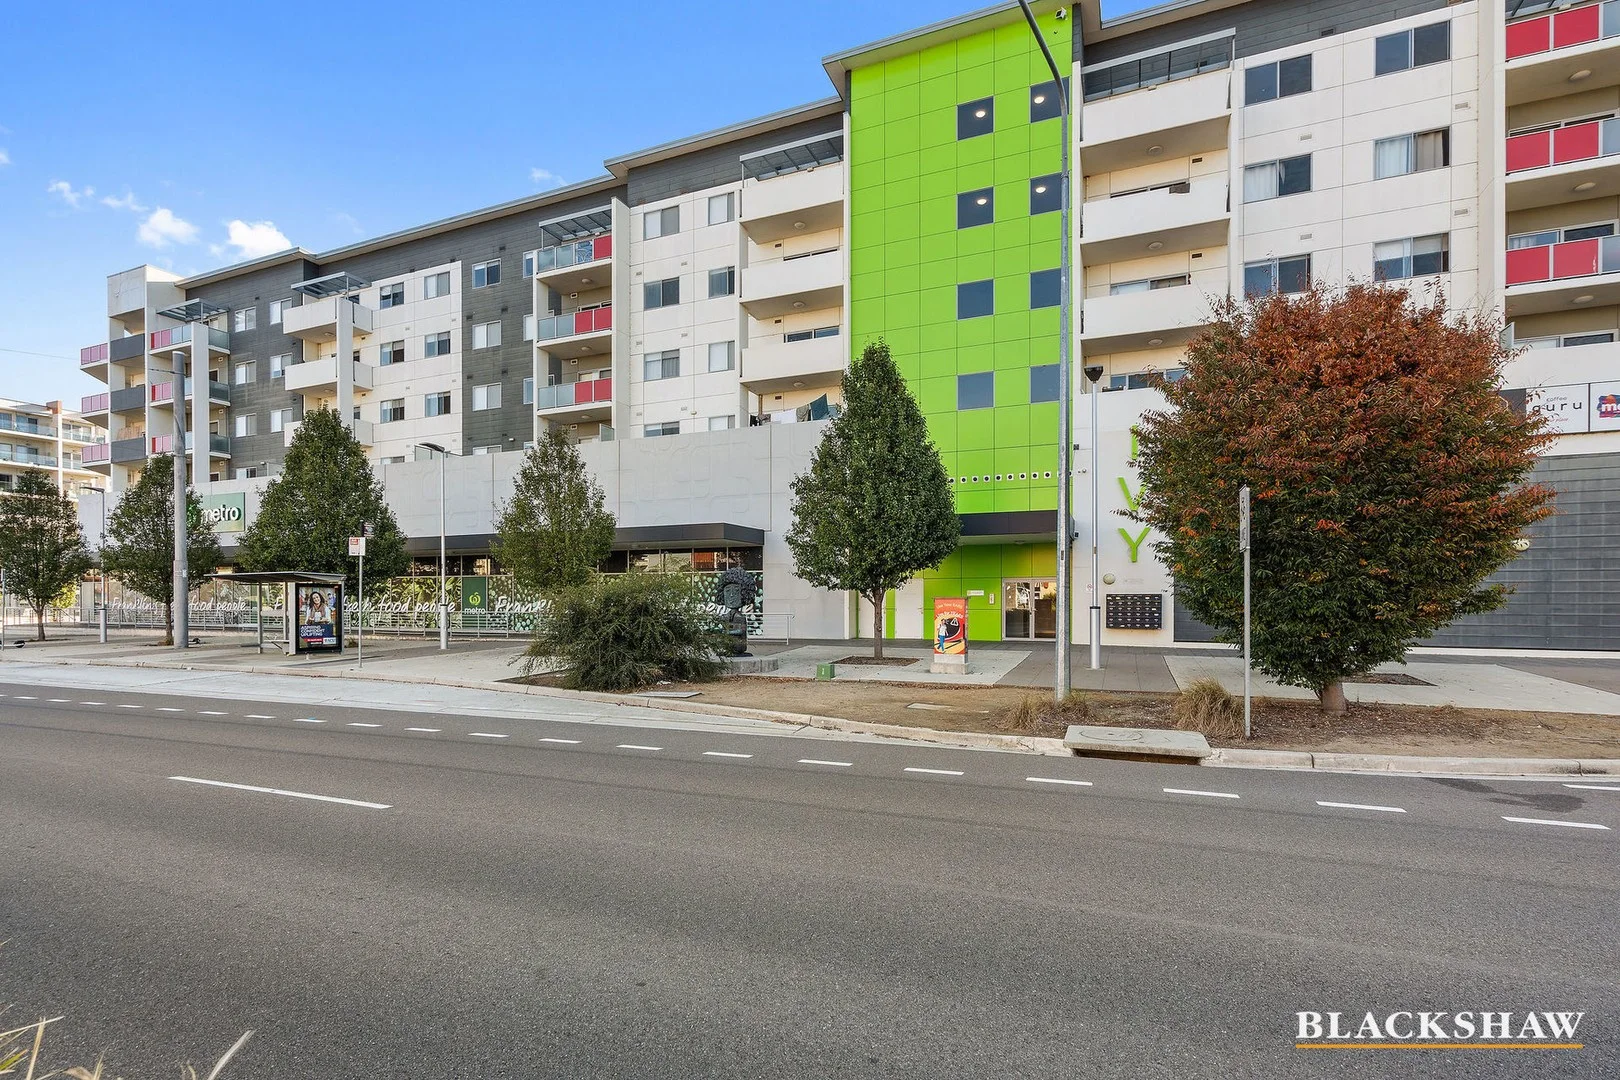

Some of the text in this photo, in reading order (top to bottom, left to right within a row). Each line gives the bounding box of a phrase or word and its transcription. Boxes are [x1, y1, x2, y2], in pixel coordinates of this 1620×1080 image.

[201, 504, 240, 522] metro
[189, 595, 213, 617] food
[215, 597, 247, 617] people
[378, 594, 411, 620] food
[463, 607, 486, 615] metro
